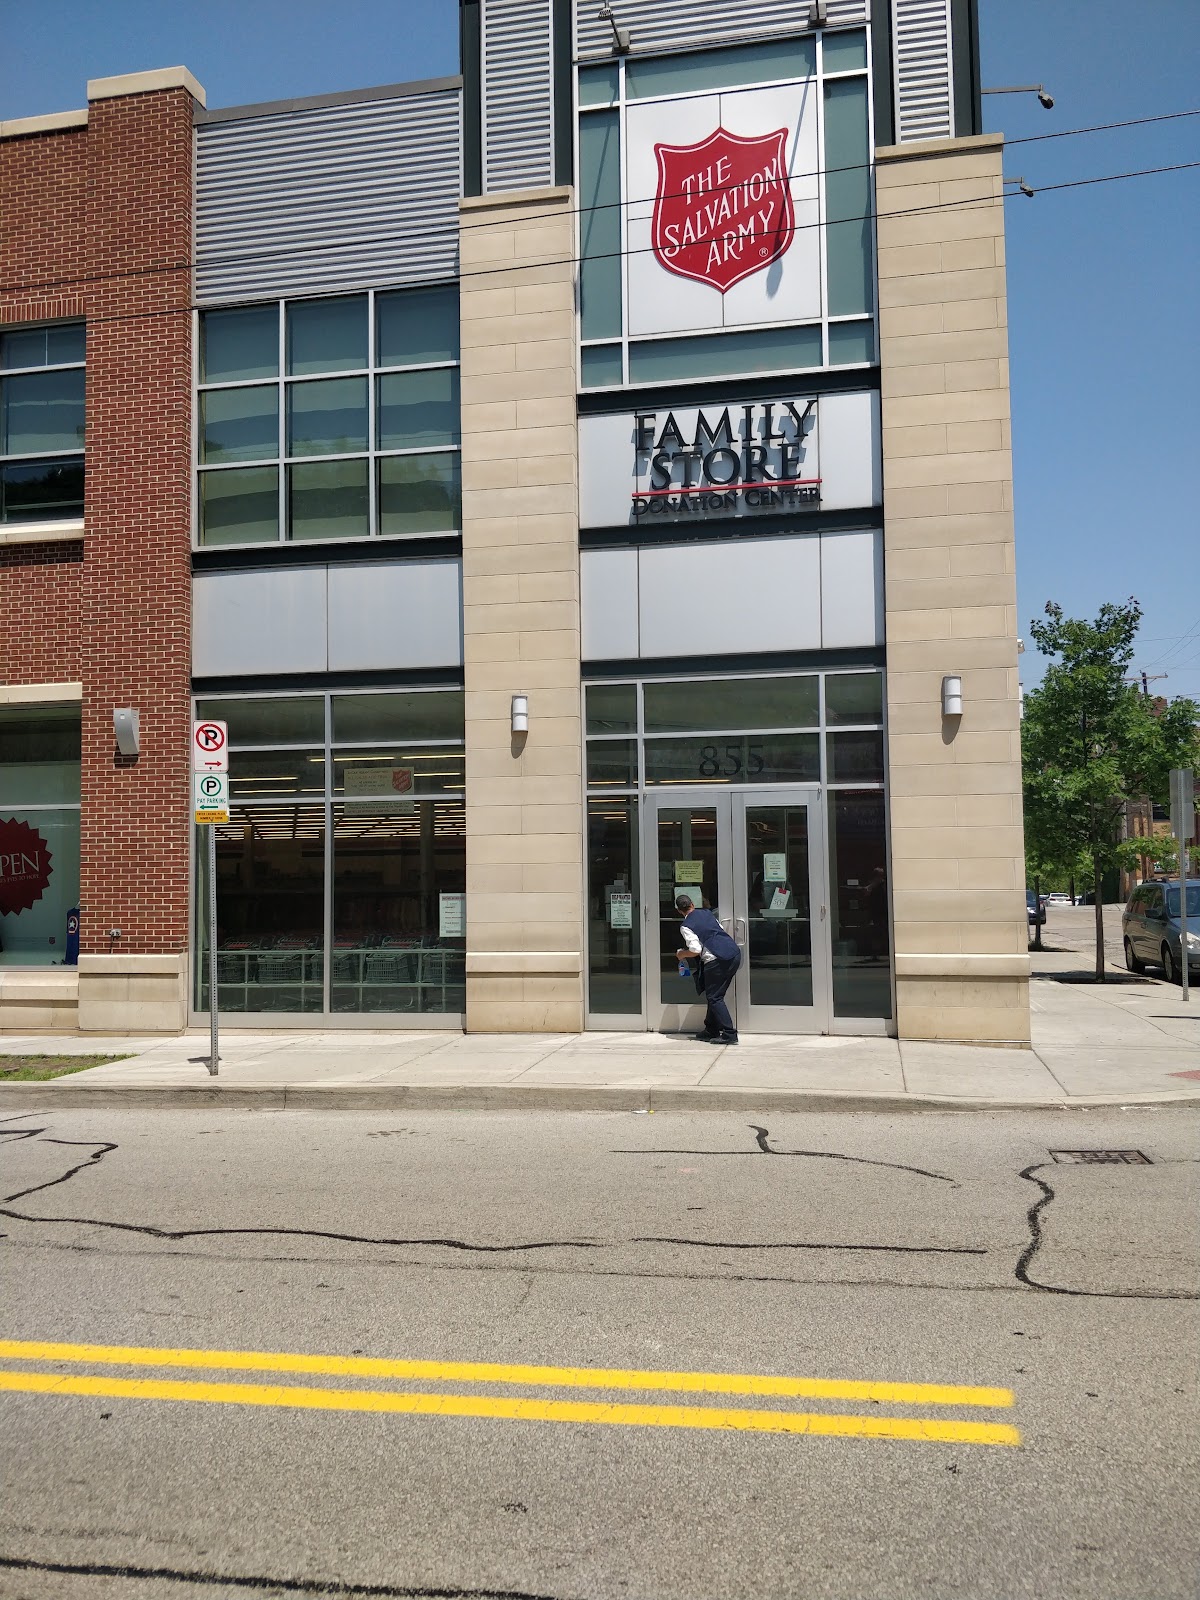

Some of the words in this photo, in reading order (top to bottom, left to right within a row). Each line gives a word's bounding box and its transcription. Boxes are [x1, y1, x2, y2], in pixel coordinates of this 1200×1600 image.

[682, 155, 732, 206] THE
[664, 157, 778, 258] SALVATION
[705, 201, 775, 274] ARMY
[634, 400, 818, 450] FAMILY
[651, 442, 801, 490] STORE
[632, 494, 737, 516] DONATION
[745, 487, 823, 507] CENTER
[205, 730, 217, 745] P
[699, 744, 764, 777] 855
[206, 781, 217, 792] P
